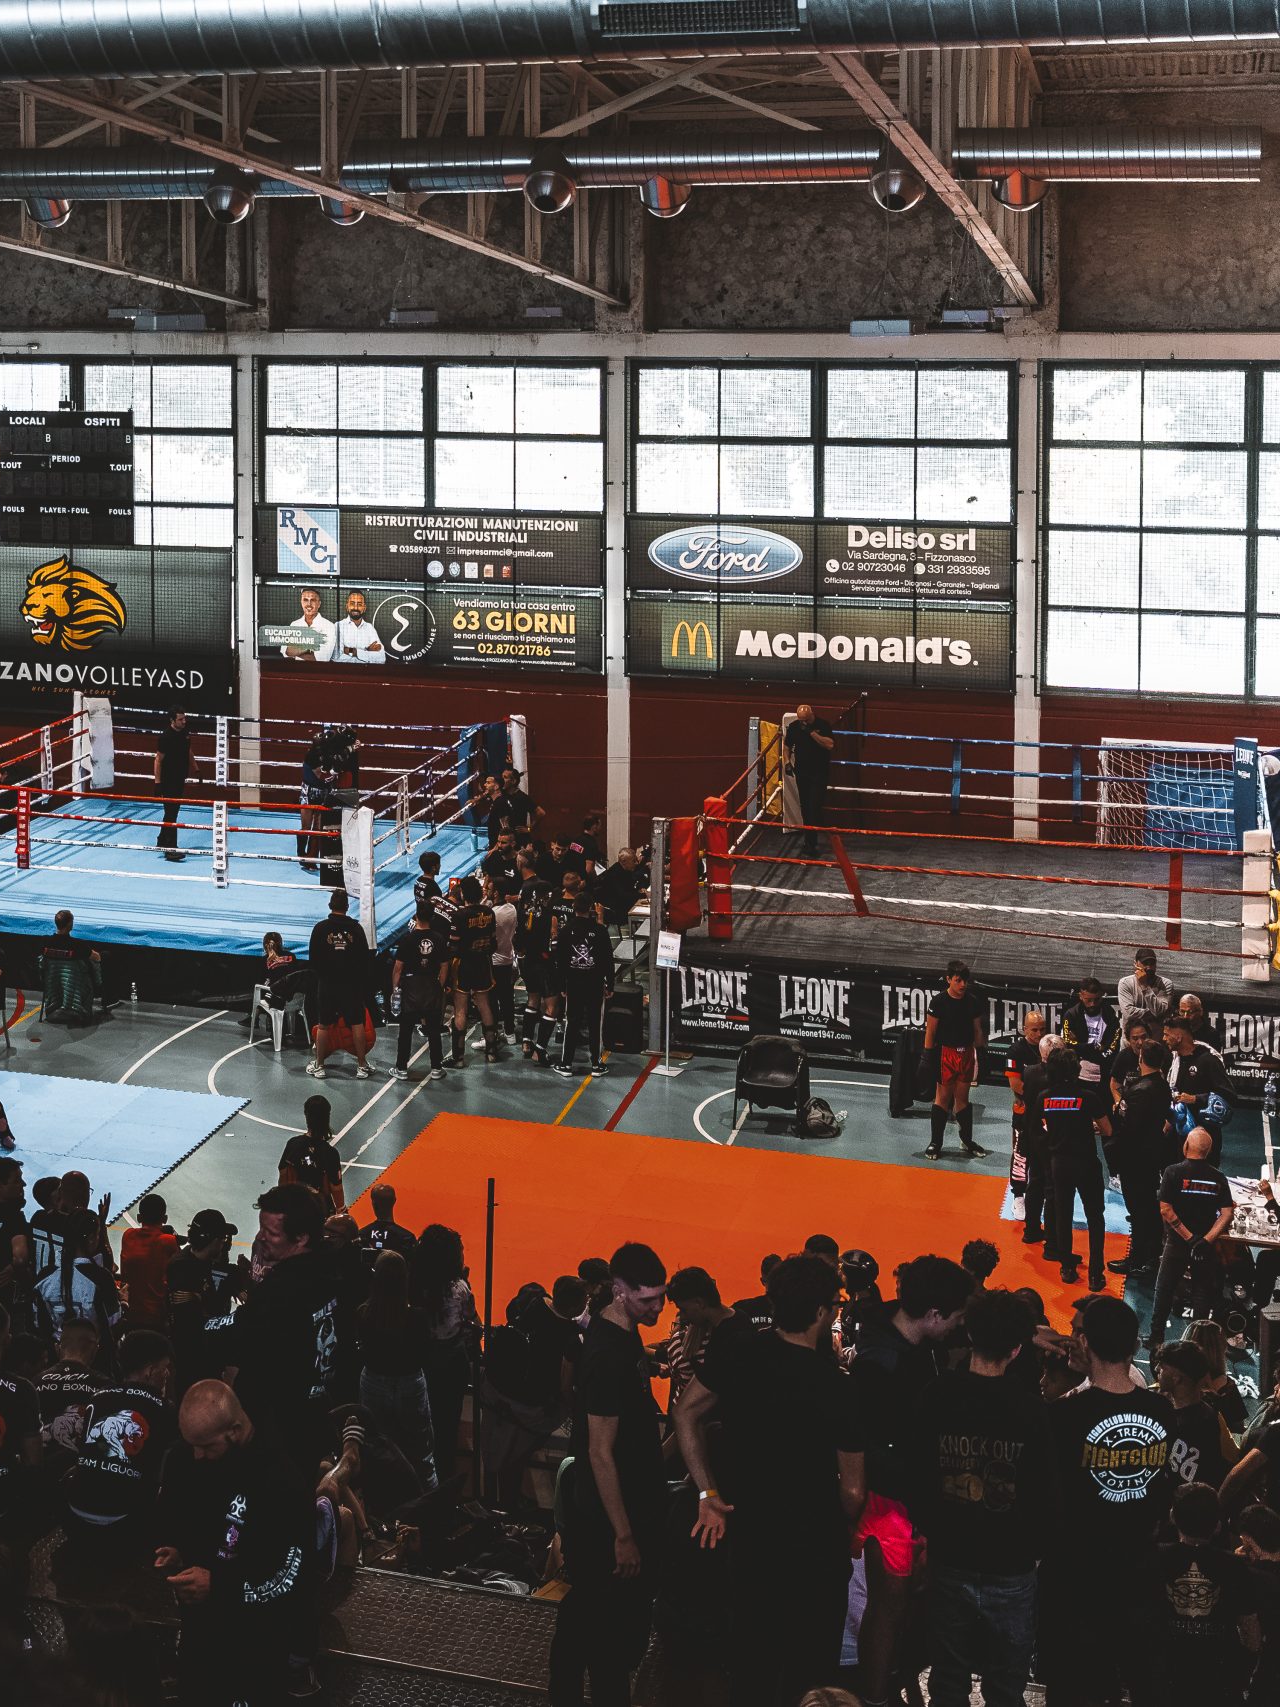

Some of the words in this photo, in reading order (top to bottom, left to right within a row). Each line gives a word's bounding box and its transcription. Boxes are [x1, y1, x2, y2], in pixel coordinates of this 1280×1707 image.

[9, 416, 46, 426] LOCALI
[84, 418, 120, 426] OSPITI
[45, 434, 52, 442] B
[125, 434, 132, 444] B
[110, 464, 132, 472] T.OUT
[108, 508, 132, 516] FOULS
[364, 515, 478, 529] RISTRUTTURAZIONI
[482, 518, 578, 532] MANUTENZIONI
[414, 529, 448, 541] CIVILI
[453, 530, 528, 544] INDUSTRIALI
[847, 525, 936, 550] Deliso
[940, 528, 976, 550] srl
[679, 534, 771, 573] Ford
[847, 550, 862, 560] Via
[863, 551, 908, 562] Sardegna,
[924, 552, 976, 563] Fizzonasco
[842, 562, 854, 571] 02
[857, 562, 906, 573] 90723046
[928, 564, 944, 574] 331
[946, 565, 990, 576] 2933595
[824, 576, 850, 585] Officina
[850, 578, 884, 586] autorizzata
[885, 578, 900, 586] Ford
[904, 578, 932, 588] Diagnosi
[936, 580, 966, 588] Garanzie
[971, 582, 1000, 590] Tagliandi
[876, 586, 910, 594] pneumatici
[454, 598, 499, 608] Vendiamo
[500, 600, 510, 609] la
[511, 602, 526, 610] tua
[528, 602, 550, 610] casa
[551, 602, 576, 612] entro
[452, 610, 480, 630] 63
[485, 611, 576, 634] GIORNI
[264, 628, 302, 637] EUCALIPTO
[477, 632, 484, 640] ci
[484, 633, 518, 641] riusciamo
[526, 635, 562, 644] paghiamo
[564, 636, 576, 644] noi
[270, 636, 315, 645] IMMOBILIARE
[402, 628, 437, 662] IMMOBILIARE
[478, 643, 551, 656] 02.87021786
[678, 966, 750, 1016] LEONE
[778, 975, 852, 1027] LEONE
[882, 985, 941, 1031] LEO
[700, 1004, 730, 1014] 1947
[680, 1018, 750, 1032] www.leone1947.com
[801, 1014, 830, 1024] 1947
[779, 1027, 852, 1041] www.leone1947.com
[1232, 1053, 1264, 1061] 1947
[126, 1388, 163, 1407] BOXING
[1086, 1413, 1168, 1443] FIGHTCLUBWORLD.COM
[1102, 1427, 1156, 1446] X-TREME
[939, 1434, 988, 1456] KNOCK
[993, 1440, 1024, 1462] OUT
[1080, 1441, 1168, 1468] FIGHTCLUB
[1098, 1469, 1152, 1488] BOXING
